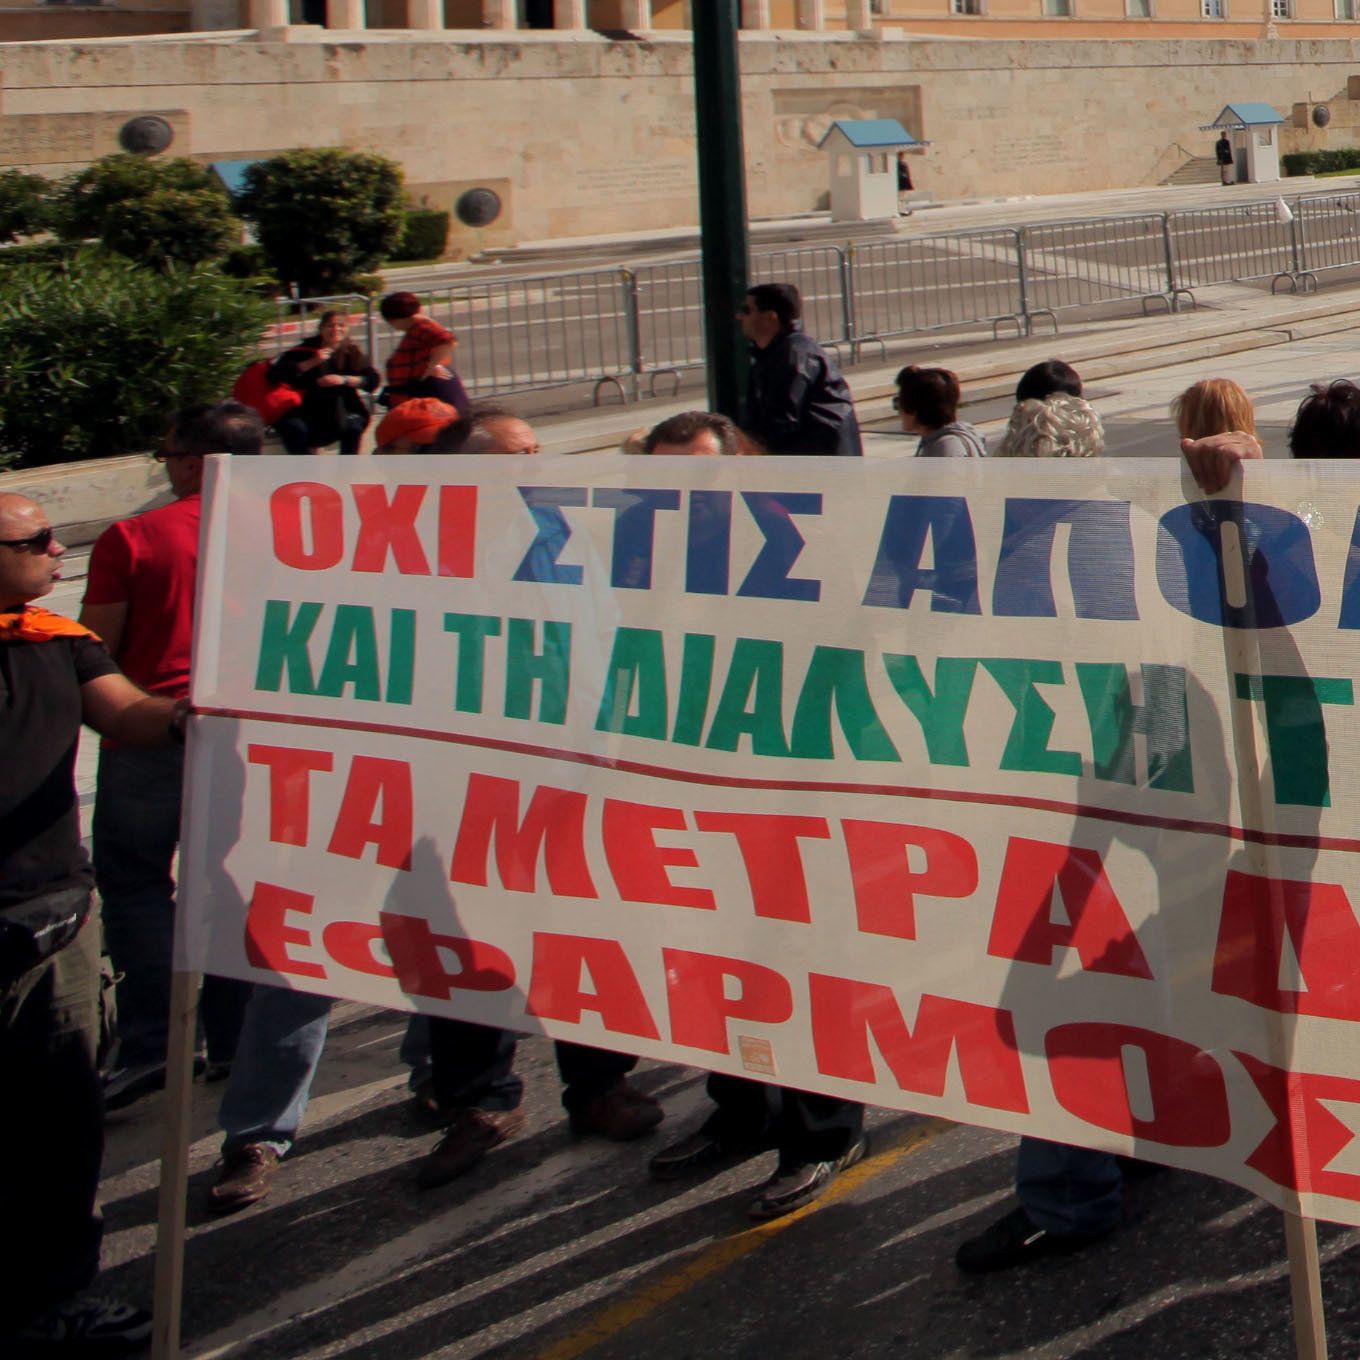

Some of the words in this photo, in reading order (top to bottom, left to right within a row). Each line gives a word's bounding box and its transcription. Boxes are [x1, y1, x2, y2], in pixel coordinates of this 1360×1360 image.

[270, 482, 478, 579] ΟΧΙ
[513, 486, 823, 603] ΣΤΙΣ
[256, 600, 417, 705] ΚΑΙ
[442, 613, 572, 726] ΤΗ
[595, 627, 1195, 795] ΔΙΑΛΥΣΗ
[246, 744, 413, 873] ΤΑ
[451, 772, 1155, 982] ΜΕΤΡΑ
